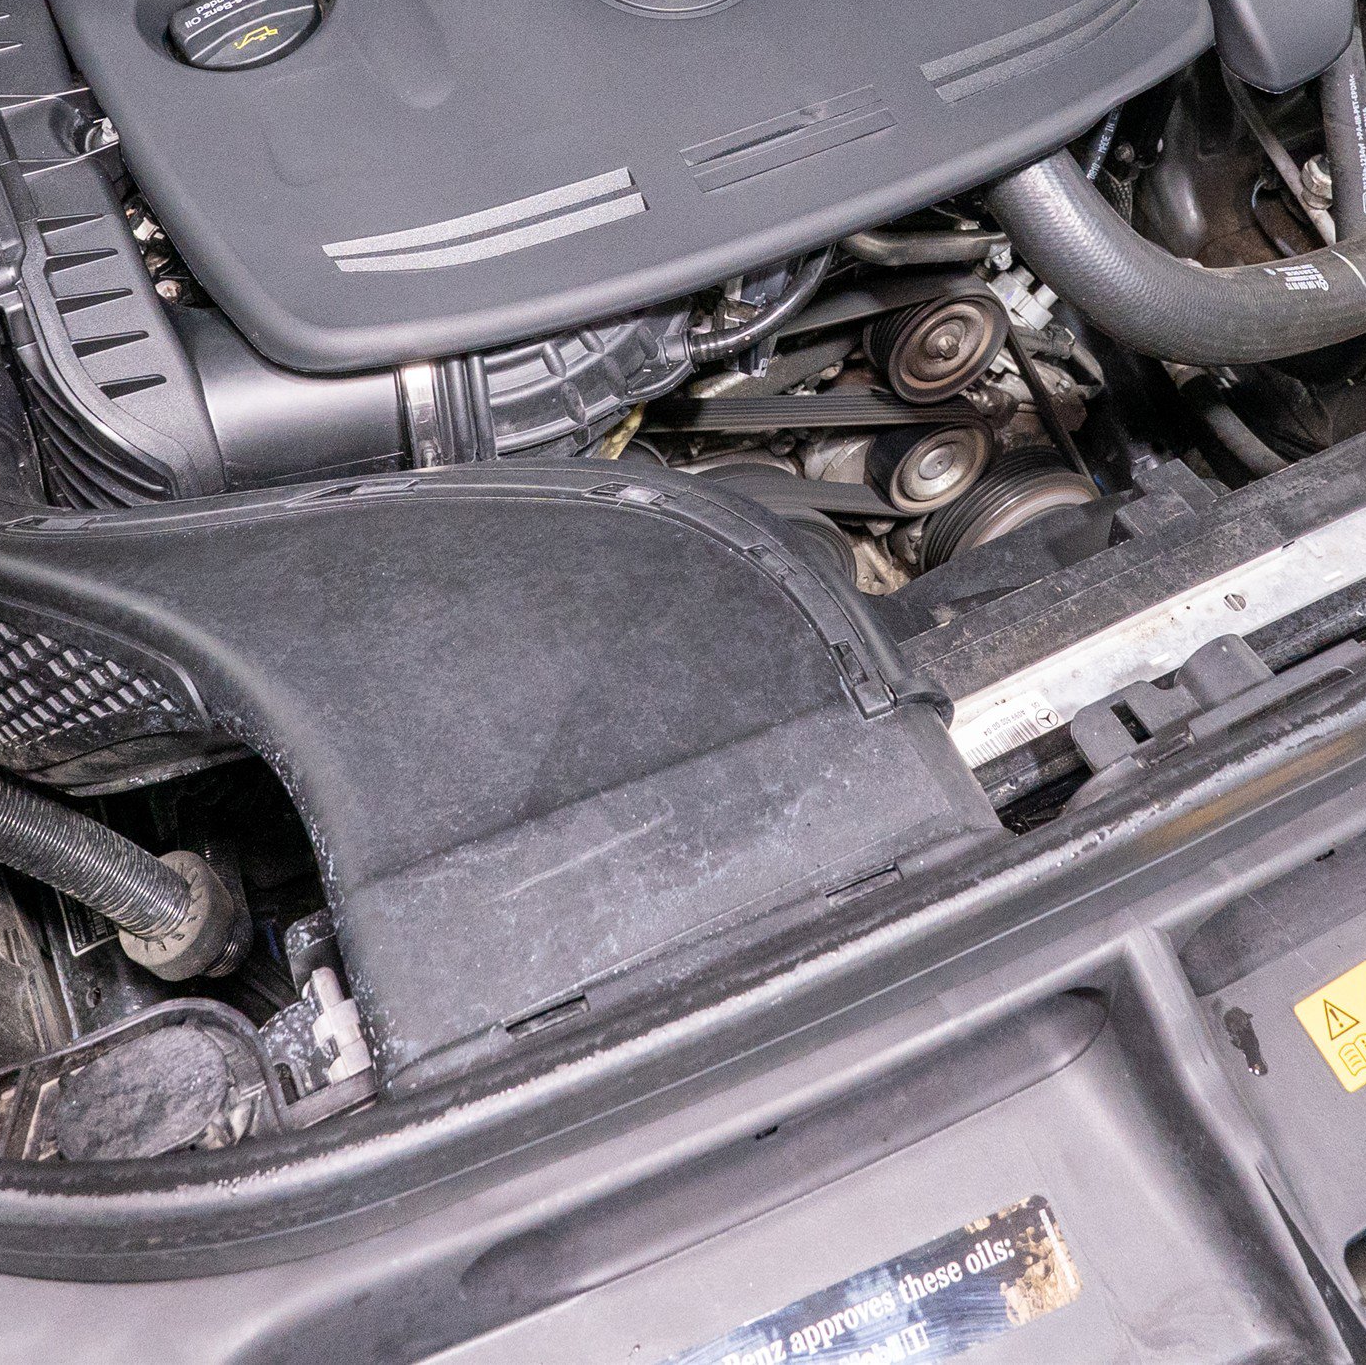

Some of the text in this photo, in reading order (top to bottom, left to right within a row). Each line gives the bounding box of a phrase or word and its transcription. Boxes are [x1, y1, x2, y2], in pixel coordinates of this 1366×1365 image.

[184, 15, 202, 30] Oil
[789, 1289, 896, 1355] approves
[897, 1260, 964, 1304] these
[964, 1236, 1017, 1275] oils:
